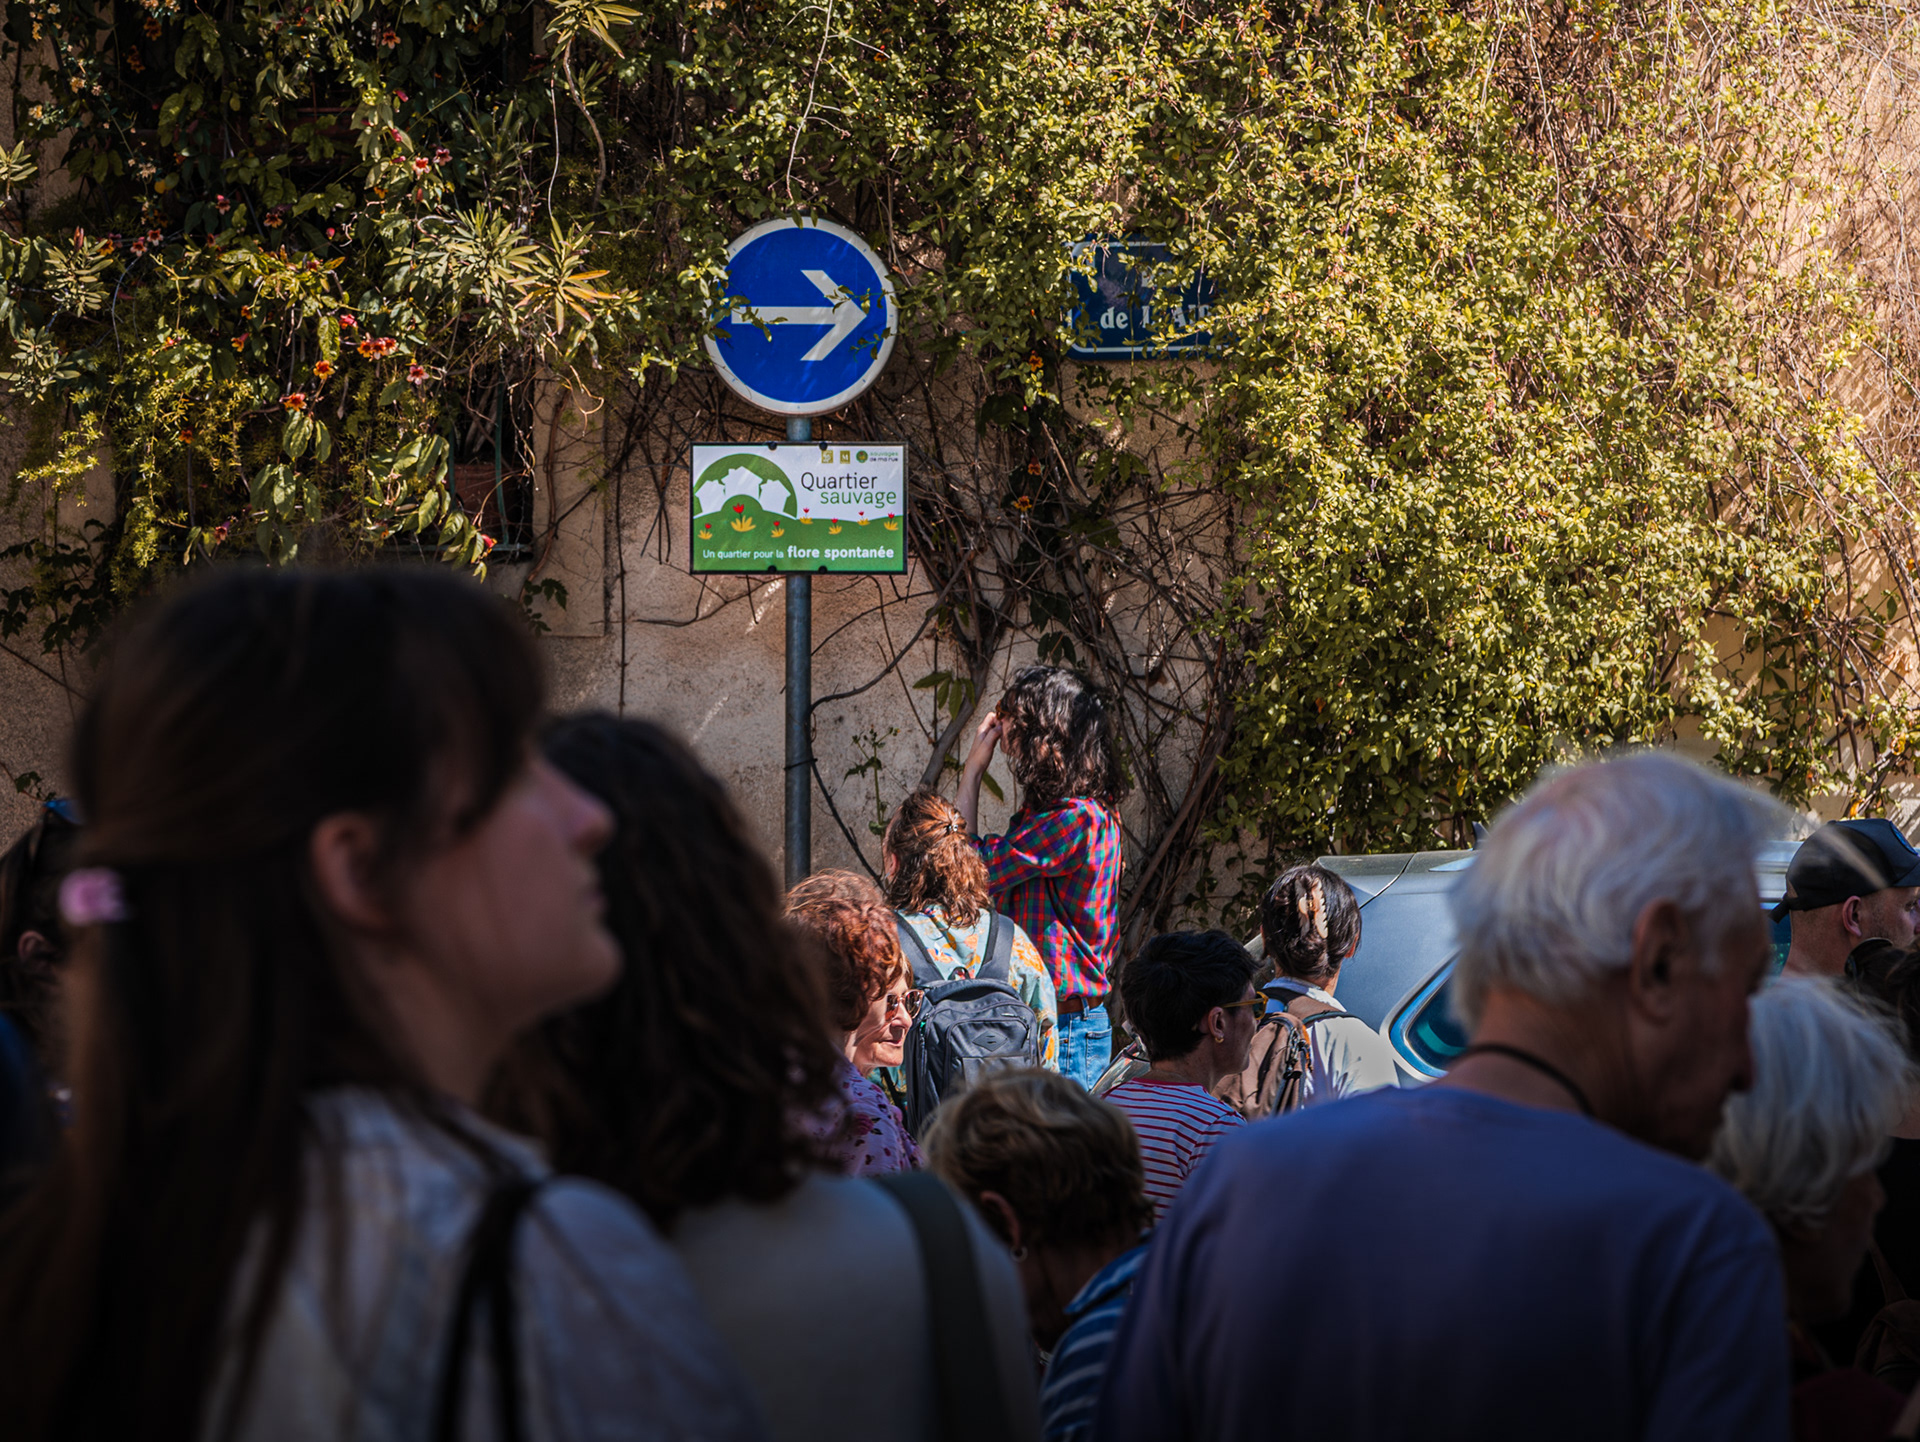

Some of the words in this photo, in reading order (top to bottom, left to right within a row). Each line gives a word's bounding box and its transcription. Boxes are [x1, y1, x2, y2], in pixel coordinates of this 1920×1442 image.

[1100, 306, 1128, 329] de
[801, 472, 878, 491] Quartier
[820, 491, 897, 508] sauvage
[702, 550, 716, 559] Un
[718, 550, 752, 560] quartier
[754, 551, 774, 560] pour
[776, 550, 784, 559] la
[788, 546, 820, 559] flore
[824, 546, 894, 561] spontanée
